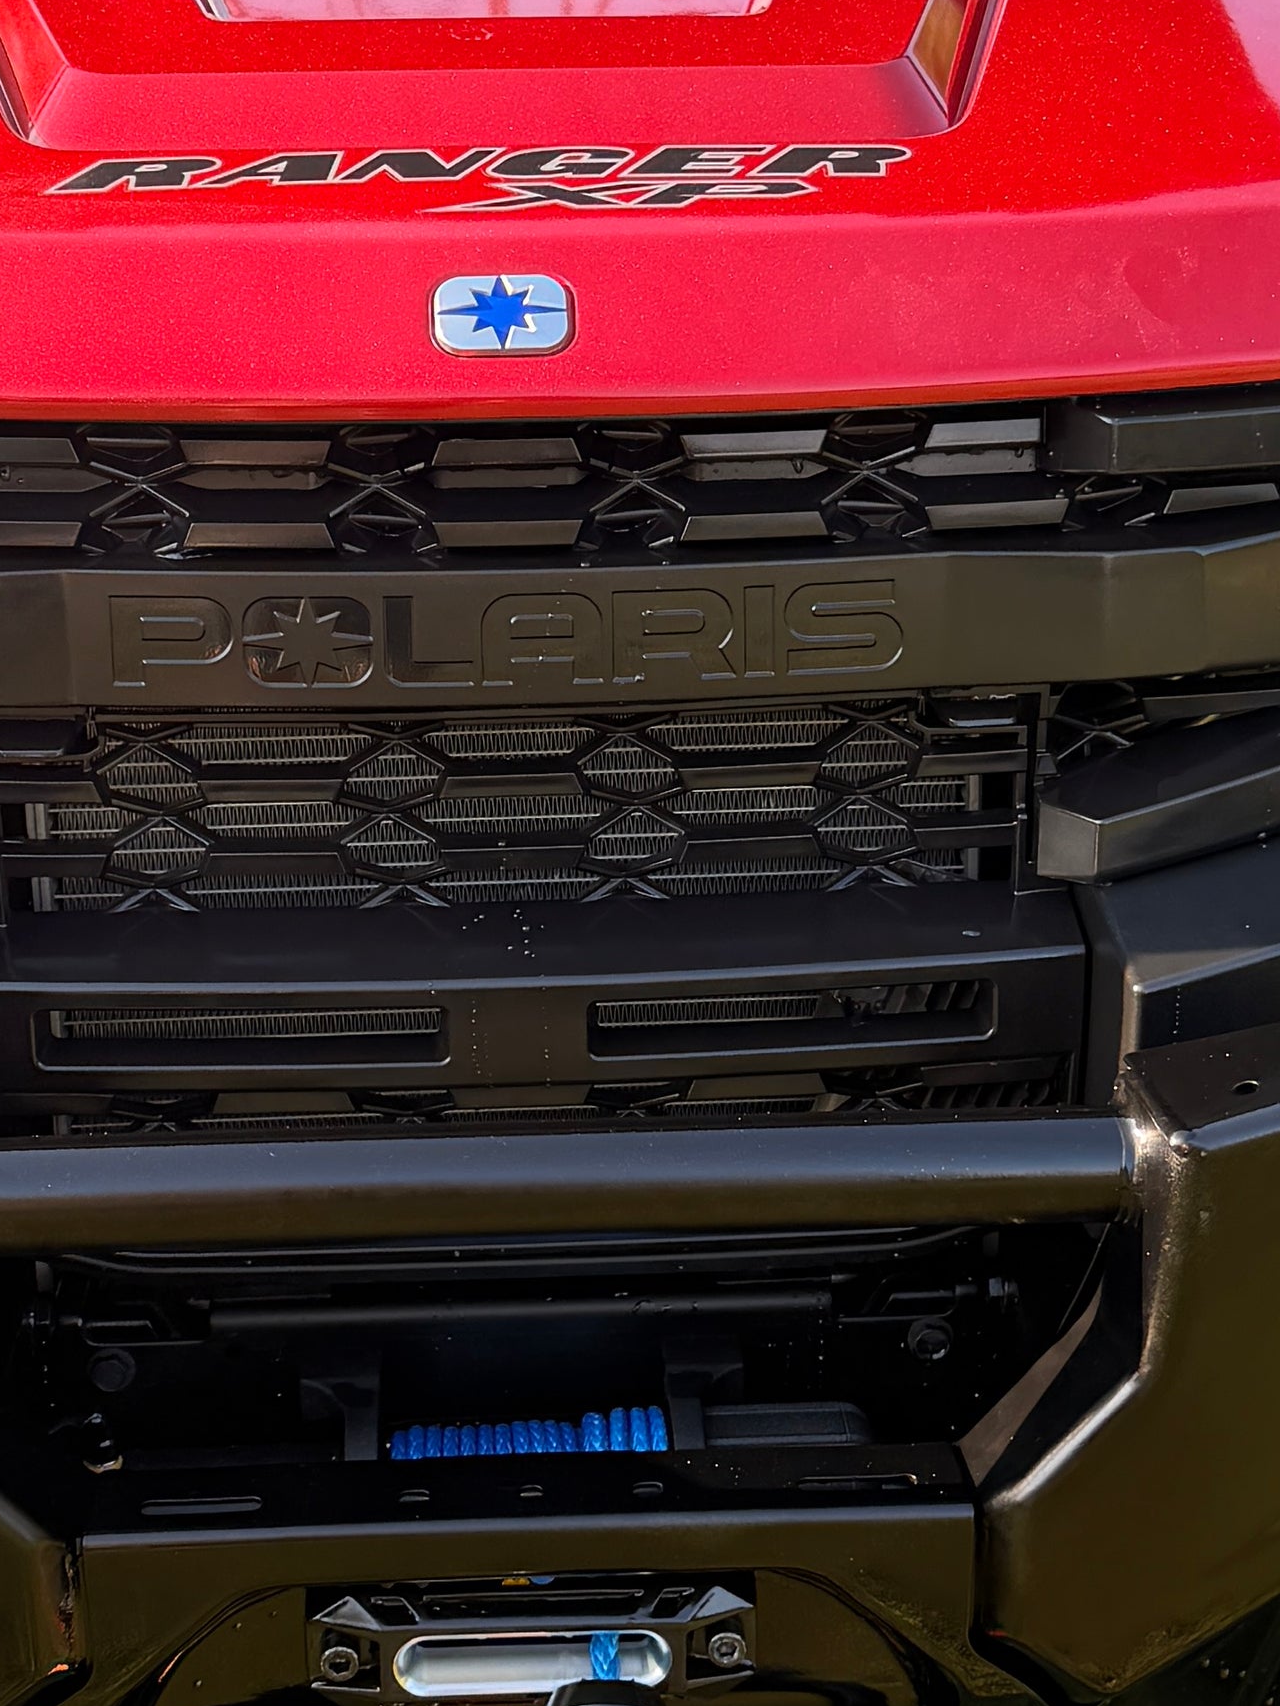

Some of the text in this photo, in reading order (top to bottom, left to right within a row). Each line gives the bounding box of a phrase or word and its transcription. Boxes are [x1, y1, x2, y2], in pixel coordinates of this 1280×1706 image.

[42, 142, 914, 196] RANGER
[422, 180, 824, 214] XP
[107, 577, 905, 689] POLARIS
